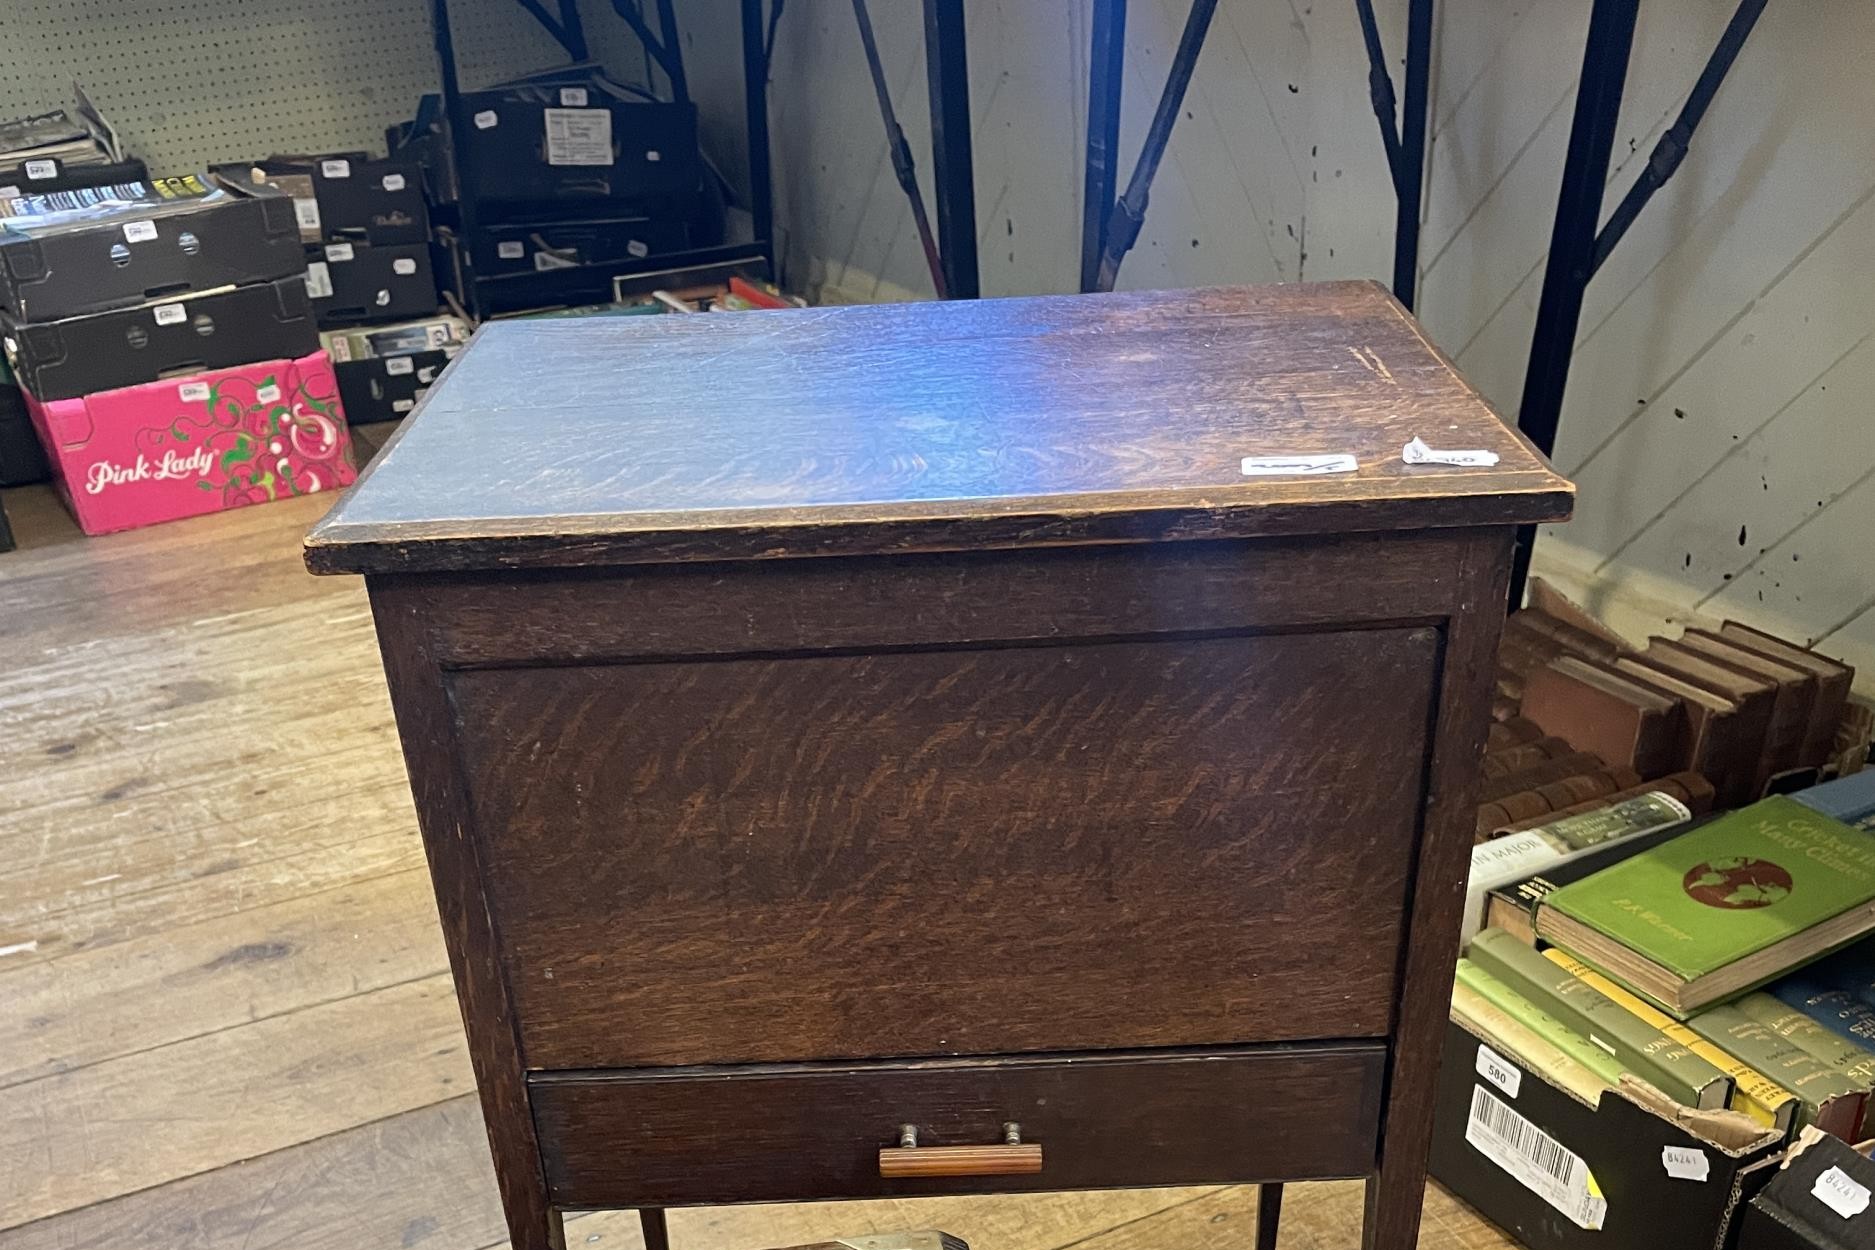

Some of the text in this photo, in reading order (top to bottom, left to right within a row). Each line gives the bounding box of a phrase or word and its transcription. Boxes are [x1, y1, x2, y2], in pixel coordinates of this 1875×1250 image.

[85, 446, 214, 494] Pink Lady
[1488, 1064, 1506, 1085] 580
[1667, 1154, 1697, 1166] 84241
